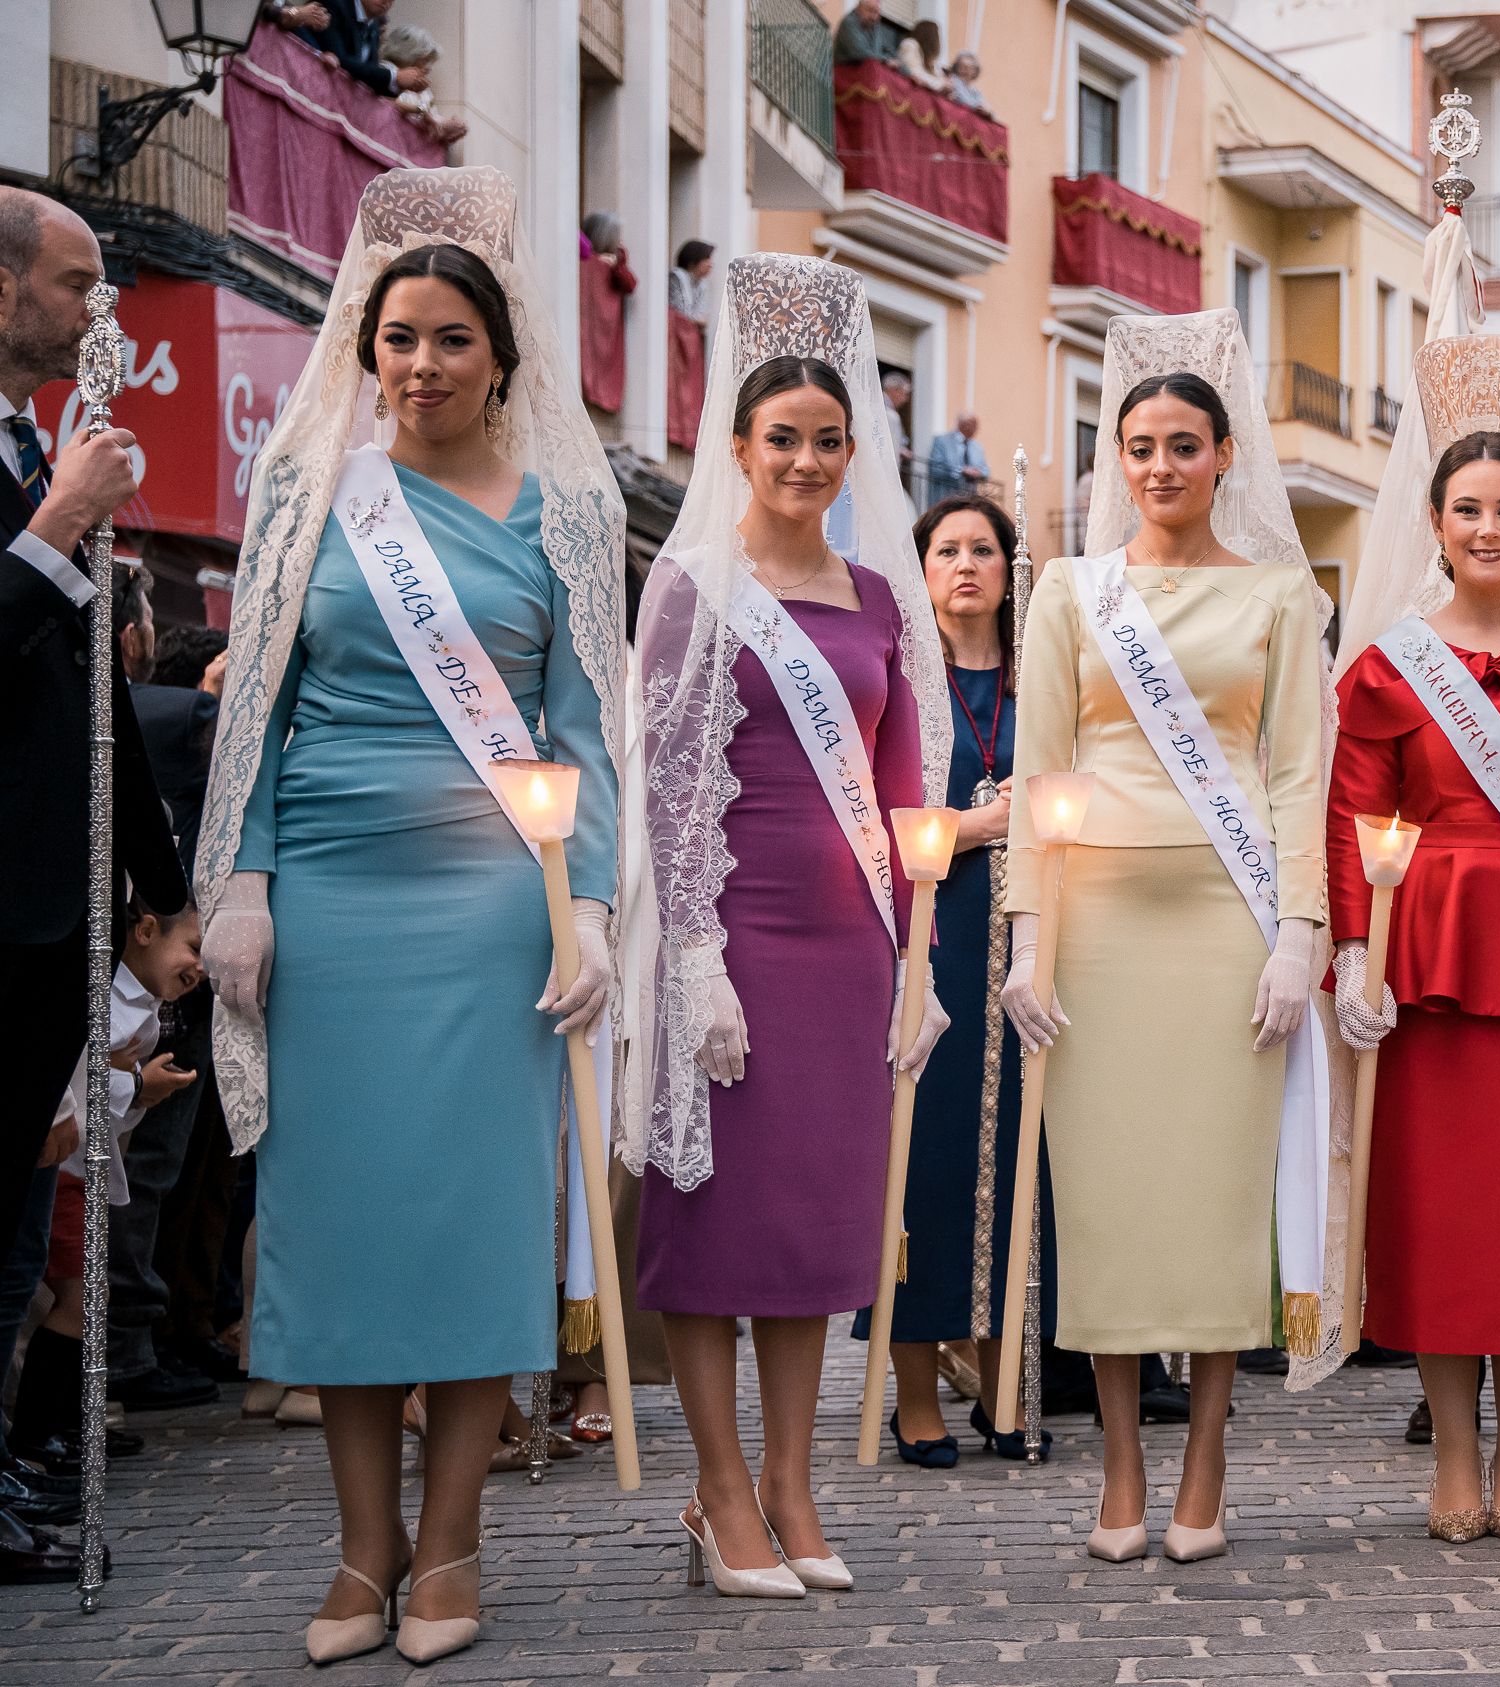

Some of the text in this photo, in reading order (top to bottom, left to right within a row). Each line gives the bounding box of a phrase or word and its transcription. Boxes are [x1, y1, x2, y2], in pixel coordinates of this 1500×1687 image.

[374, 541, 437, 628] DAMA
[436, 657, 481, 703] DE
[785, 659, 842, 753] DAMA
[841, 780, 870, 823] DE
[1113, 625, 1271, 891] DAMA DE HONOR
